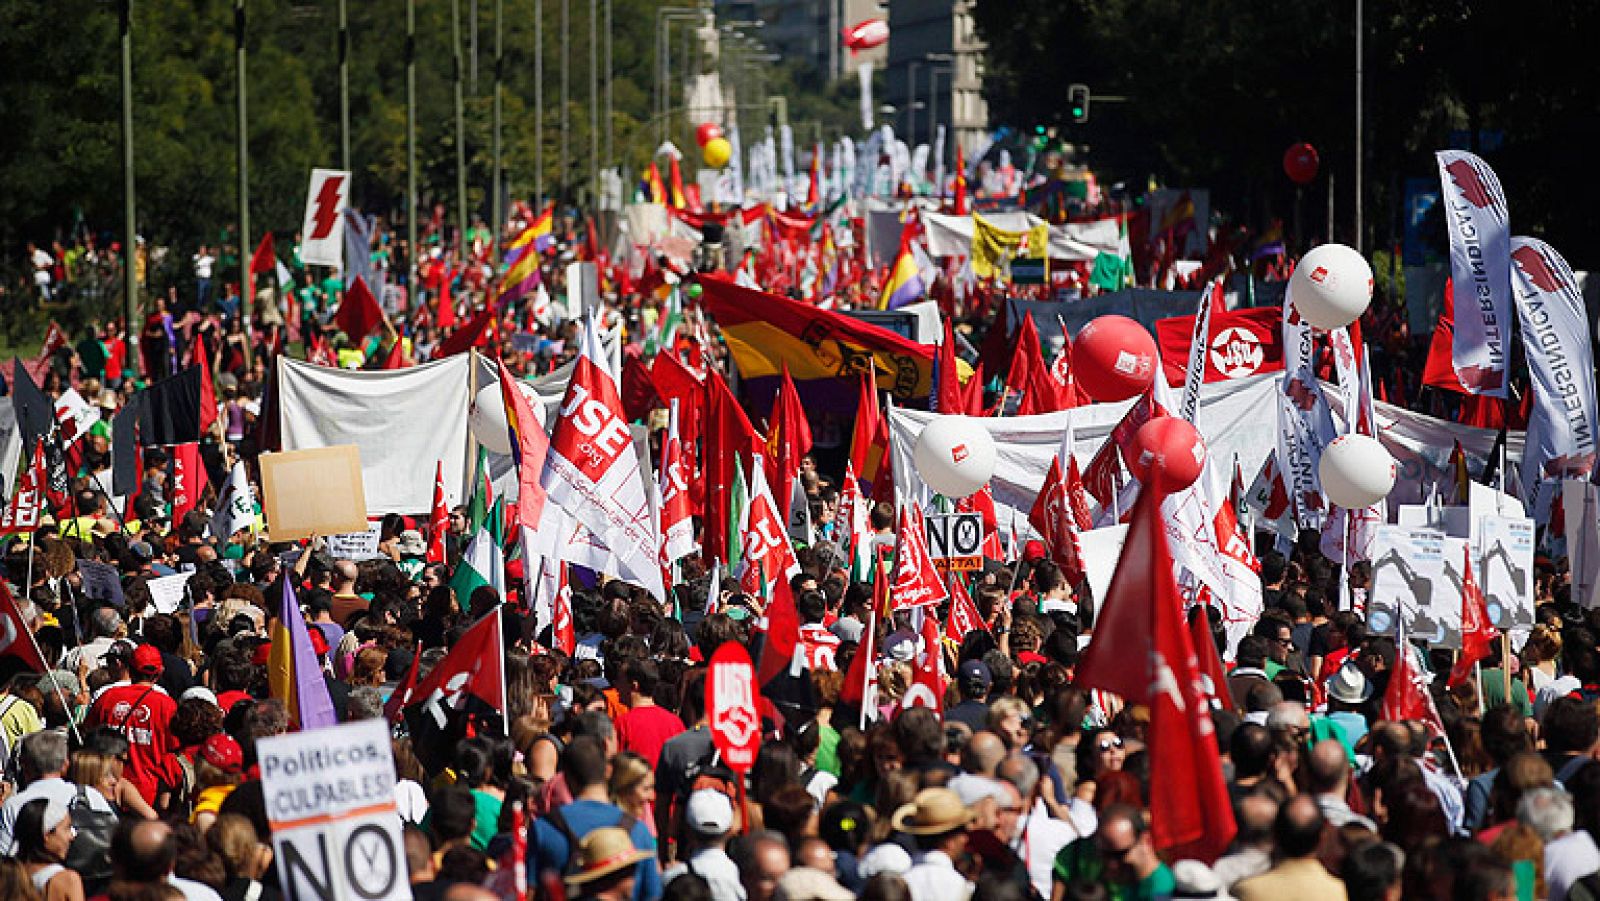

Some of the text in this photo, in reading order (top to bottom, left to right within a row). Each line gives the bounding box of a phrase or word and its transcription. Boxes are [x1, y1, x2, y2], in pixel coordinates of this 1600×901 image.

[559, 383, 631, 456] JSE
[926, 514, 980, 555] NO
[280, 823, 397, 901] NO
